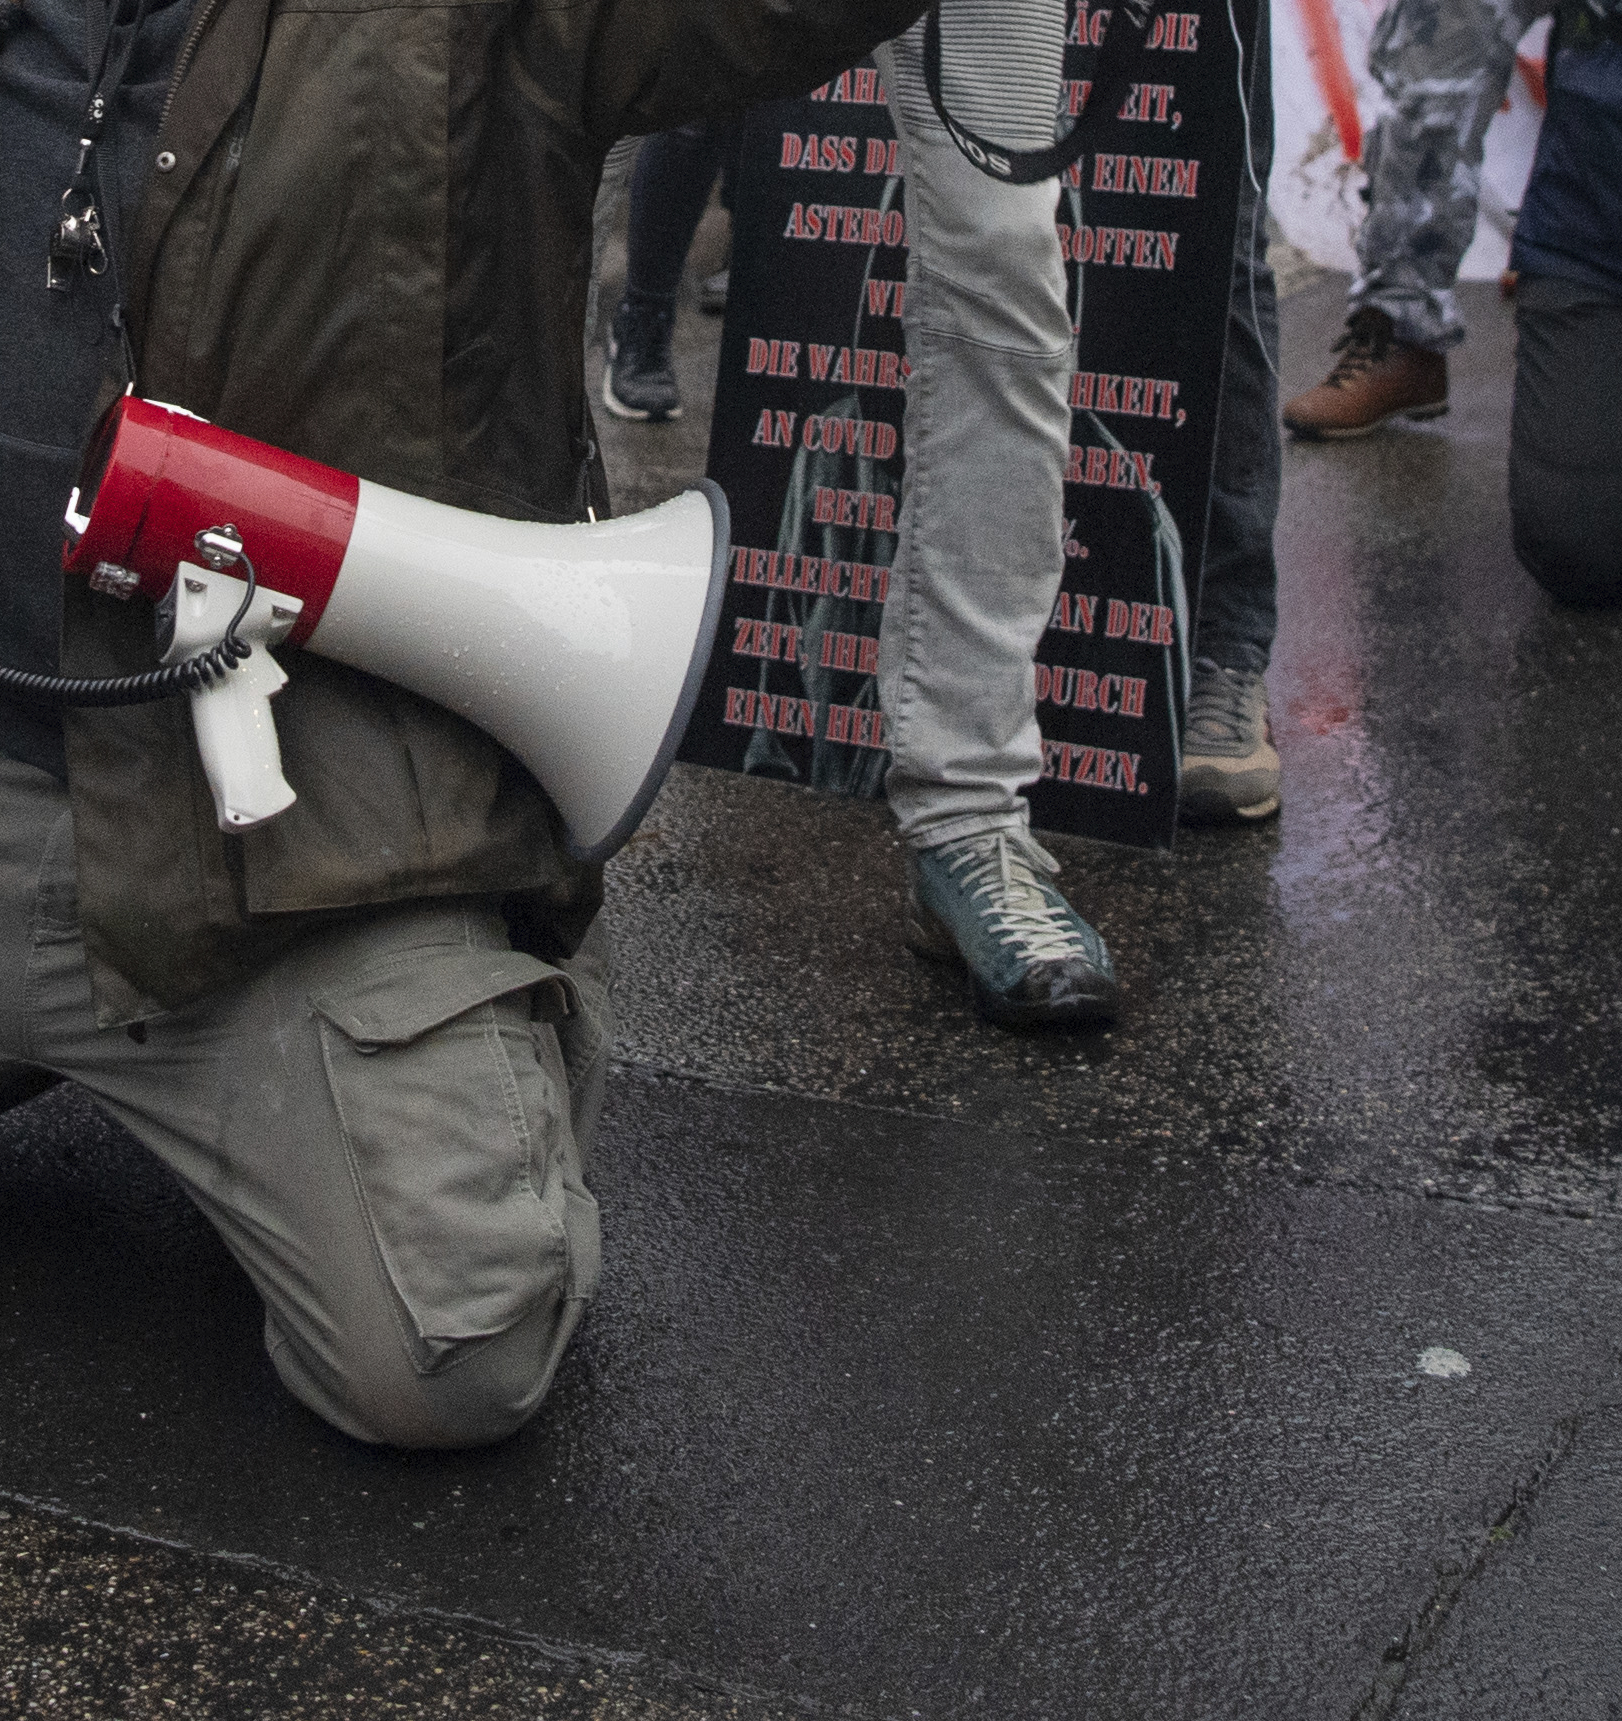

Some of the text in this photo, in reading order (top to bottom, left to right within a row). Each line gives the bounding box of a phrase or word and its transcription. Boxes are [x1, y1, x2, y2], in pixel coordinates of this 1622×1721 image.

[779, 132, 858, 173] DASS
[1091, 152, 1200, 198] EINEM
[783, 201, 910, 248] ASTERO
[746, 336, 801, 378] DIE
[751, 408, 897, 460] AN COVID
[812, 484, 898, 533] BETR
[1049, 591, 1098, 634] AN
[1105, 597, 1174, 646] DER
[732, 616, 810, 671] ZEIT,
[1034, 662, 1148, 718] DURCH
[723, 686, 820, 737] EINEN
